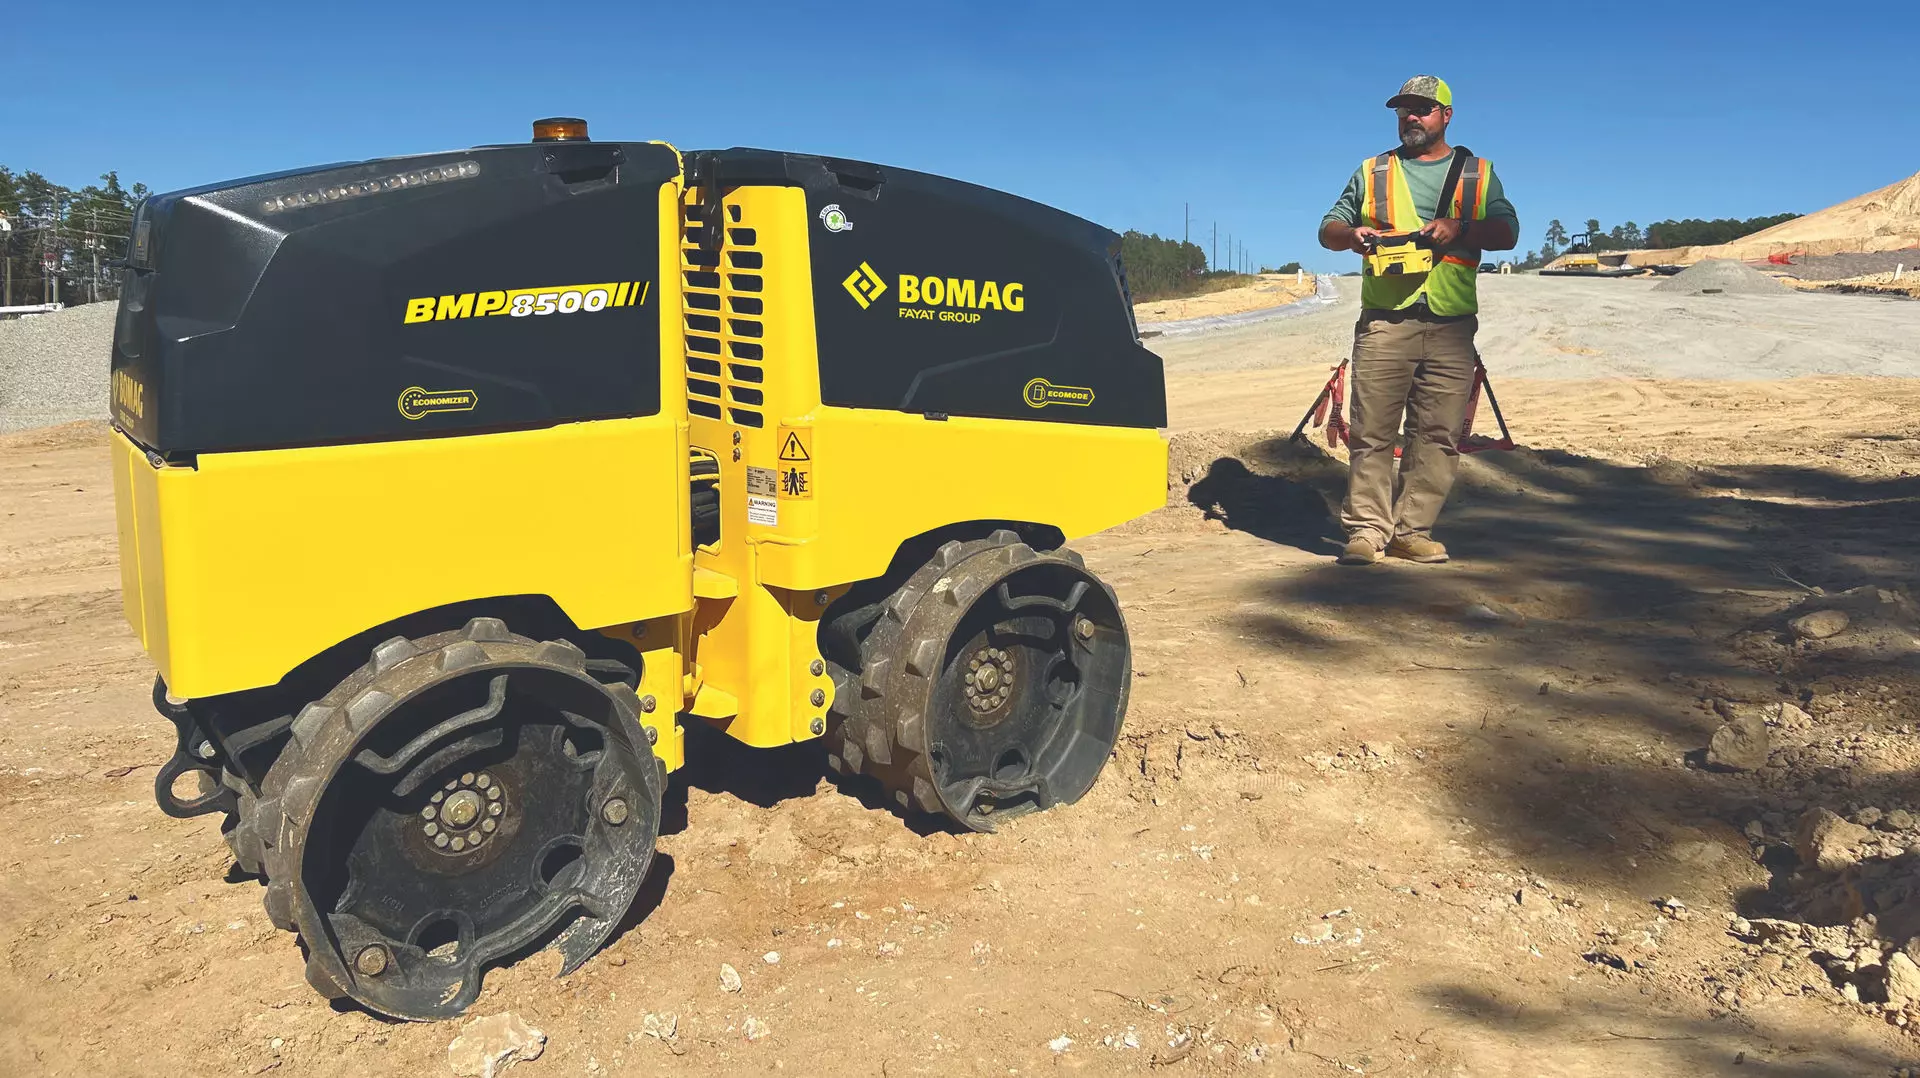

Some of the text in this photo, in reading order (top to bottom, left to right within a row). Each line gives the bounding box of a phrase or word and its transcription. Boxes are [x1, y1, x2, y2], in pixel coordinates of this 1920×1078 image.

[899, 274, 1024, 312] BOMAG
[403, 288, 609, 324] BMP 8500
[898, 308, 981, 324] FAYAT GROUP
[412, 396, 470, 407] ECONOMIZER
[1047, 390, 1089, 400] ECOMODE
